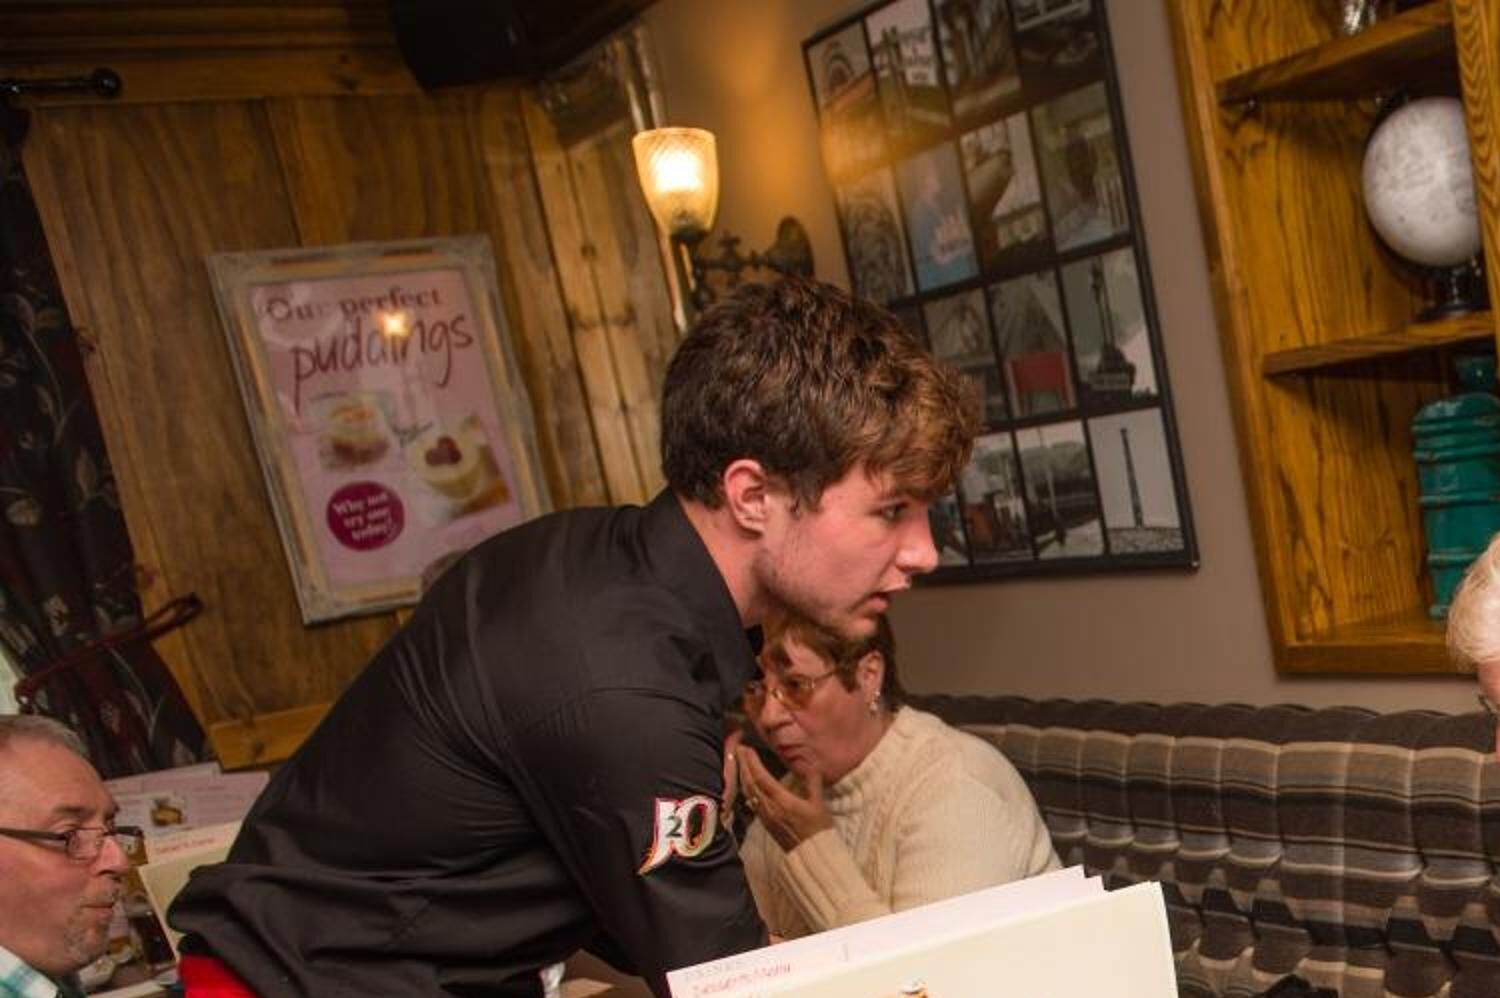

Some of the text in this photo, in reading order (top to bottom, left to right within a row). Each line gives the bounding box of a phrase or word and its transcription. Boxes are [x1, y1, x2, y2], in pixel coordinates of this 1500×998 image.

[266, 285, 441, 322] Our perfect
[290, 313, 474, 416] puddings
